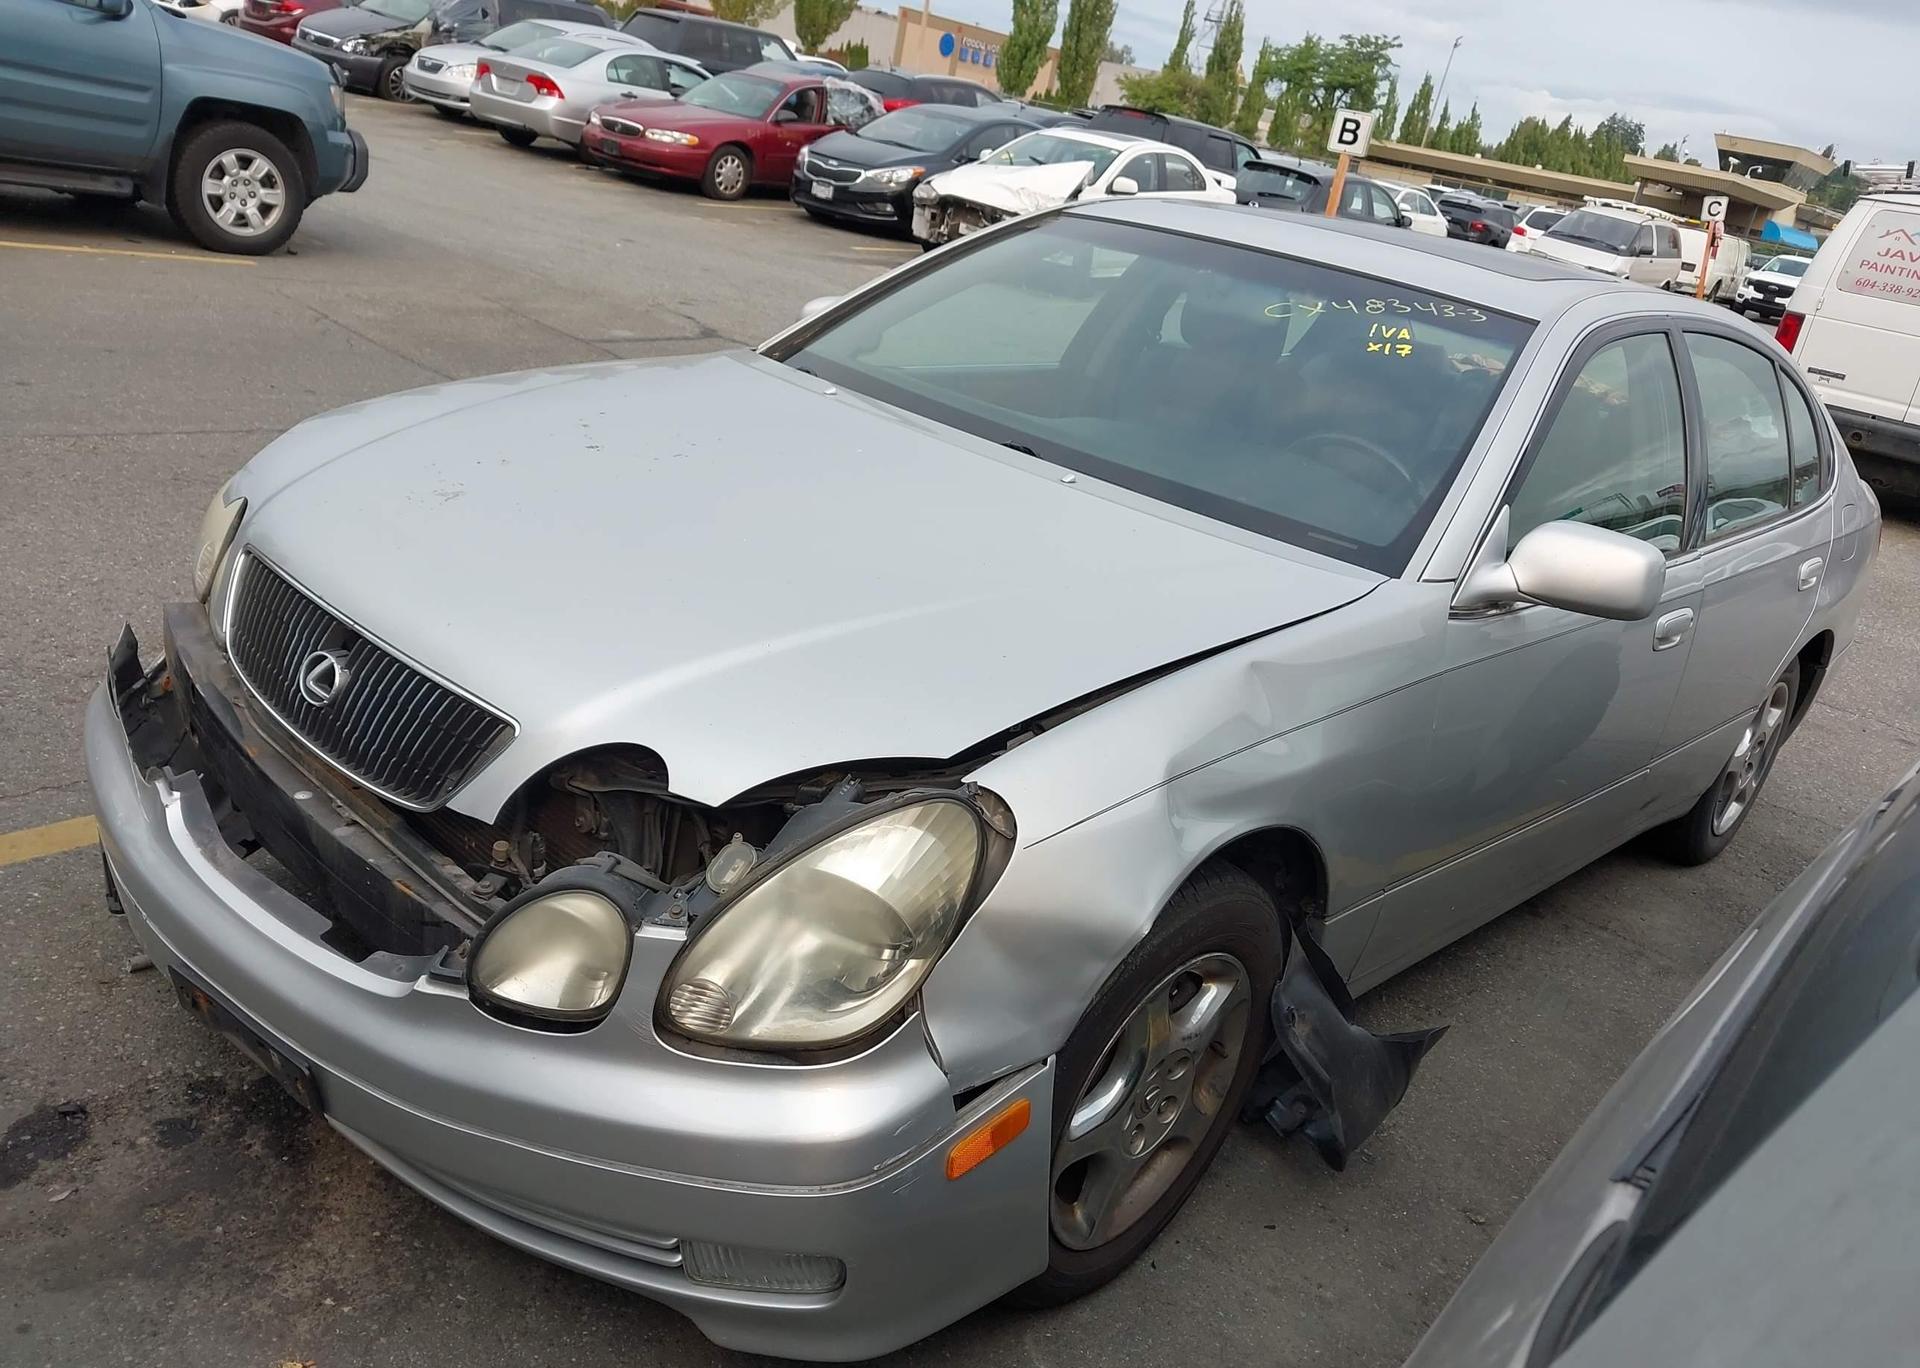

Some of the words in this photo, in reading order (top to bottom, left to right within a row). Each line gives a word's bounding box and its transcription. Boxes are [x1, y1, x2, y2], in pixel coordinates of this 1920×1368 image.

[1338, 117, 1361, 145] B
[1708, 201, 1722, 217] C
[1859, 259, 1920, 281] PAINTIN
